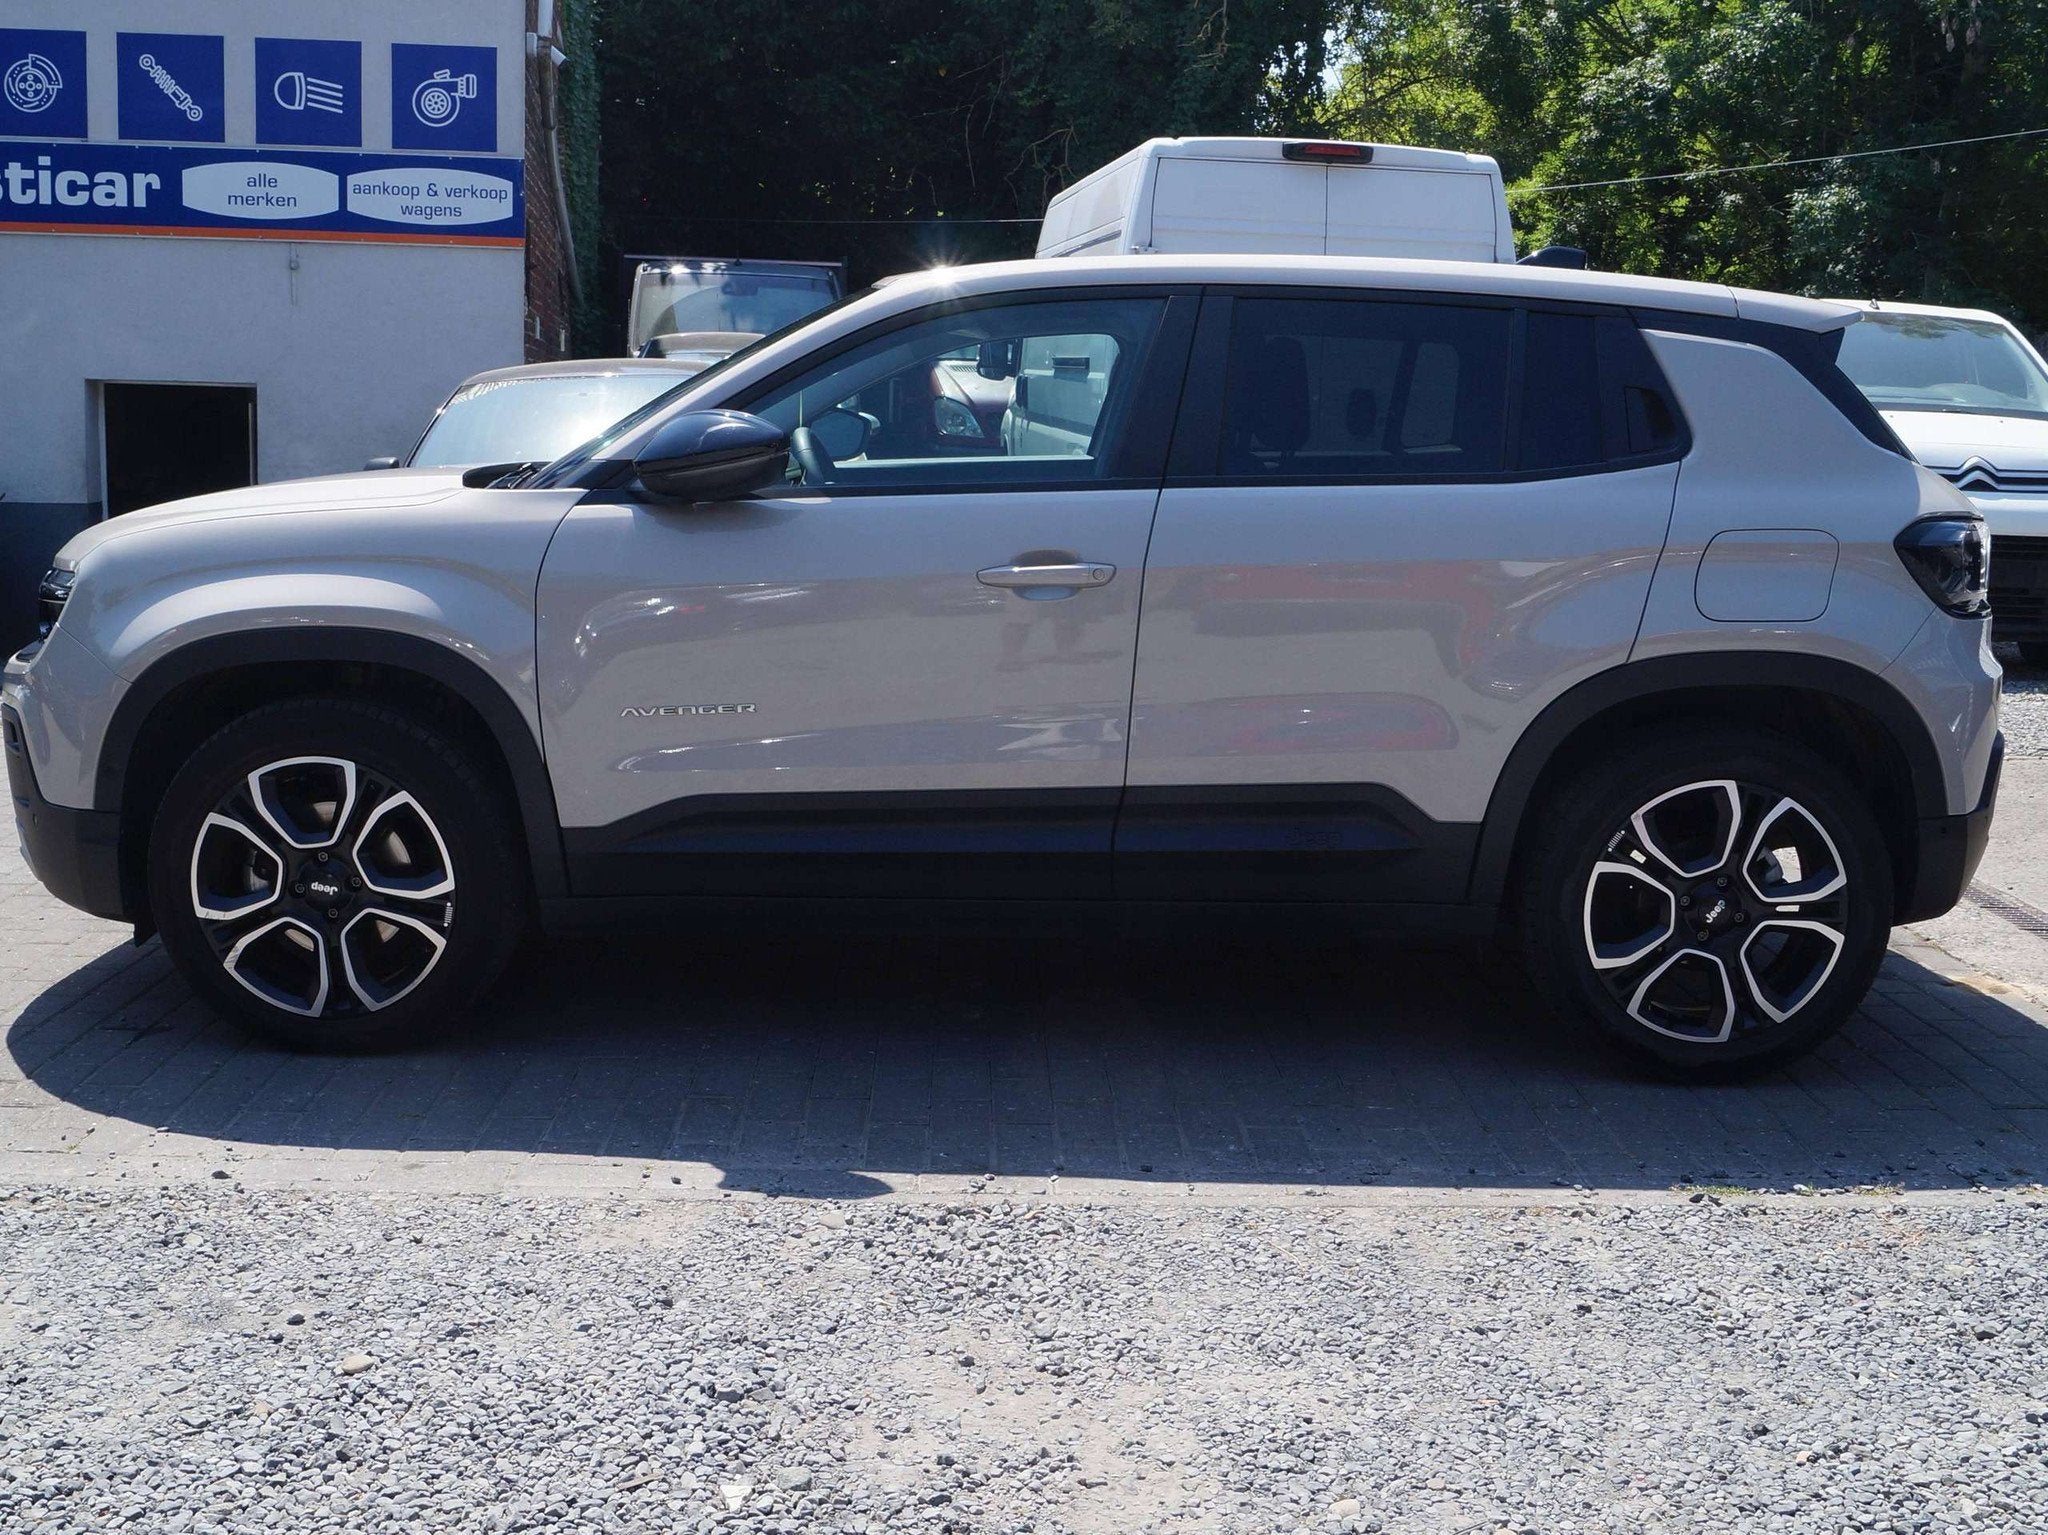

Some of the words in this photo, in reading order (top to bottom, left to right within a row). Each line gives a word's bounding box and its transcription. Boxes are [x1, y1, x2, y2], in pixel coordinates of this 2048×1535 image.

[0, 156, 161, 207] ticar
[246, 173, 278, 188] alle
[227, 192, 297, 207] merken
[352, 181, 420, 200] aankoop
[426, 182, 439, 197] &
[444, 184, 508, 203] verkoop
[400, 204, 462, 220] wagens
[620, 703, 757, 717] AVENGER
[311, 881, 338, 896] Jeep
[1705, 899, 1726, 923] Jeep
